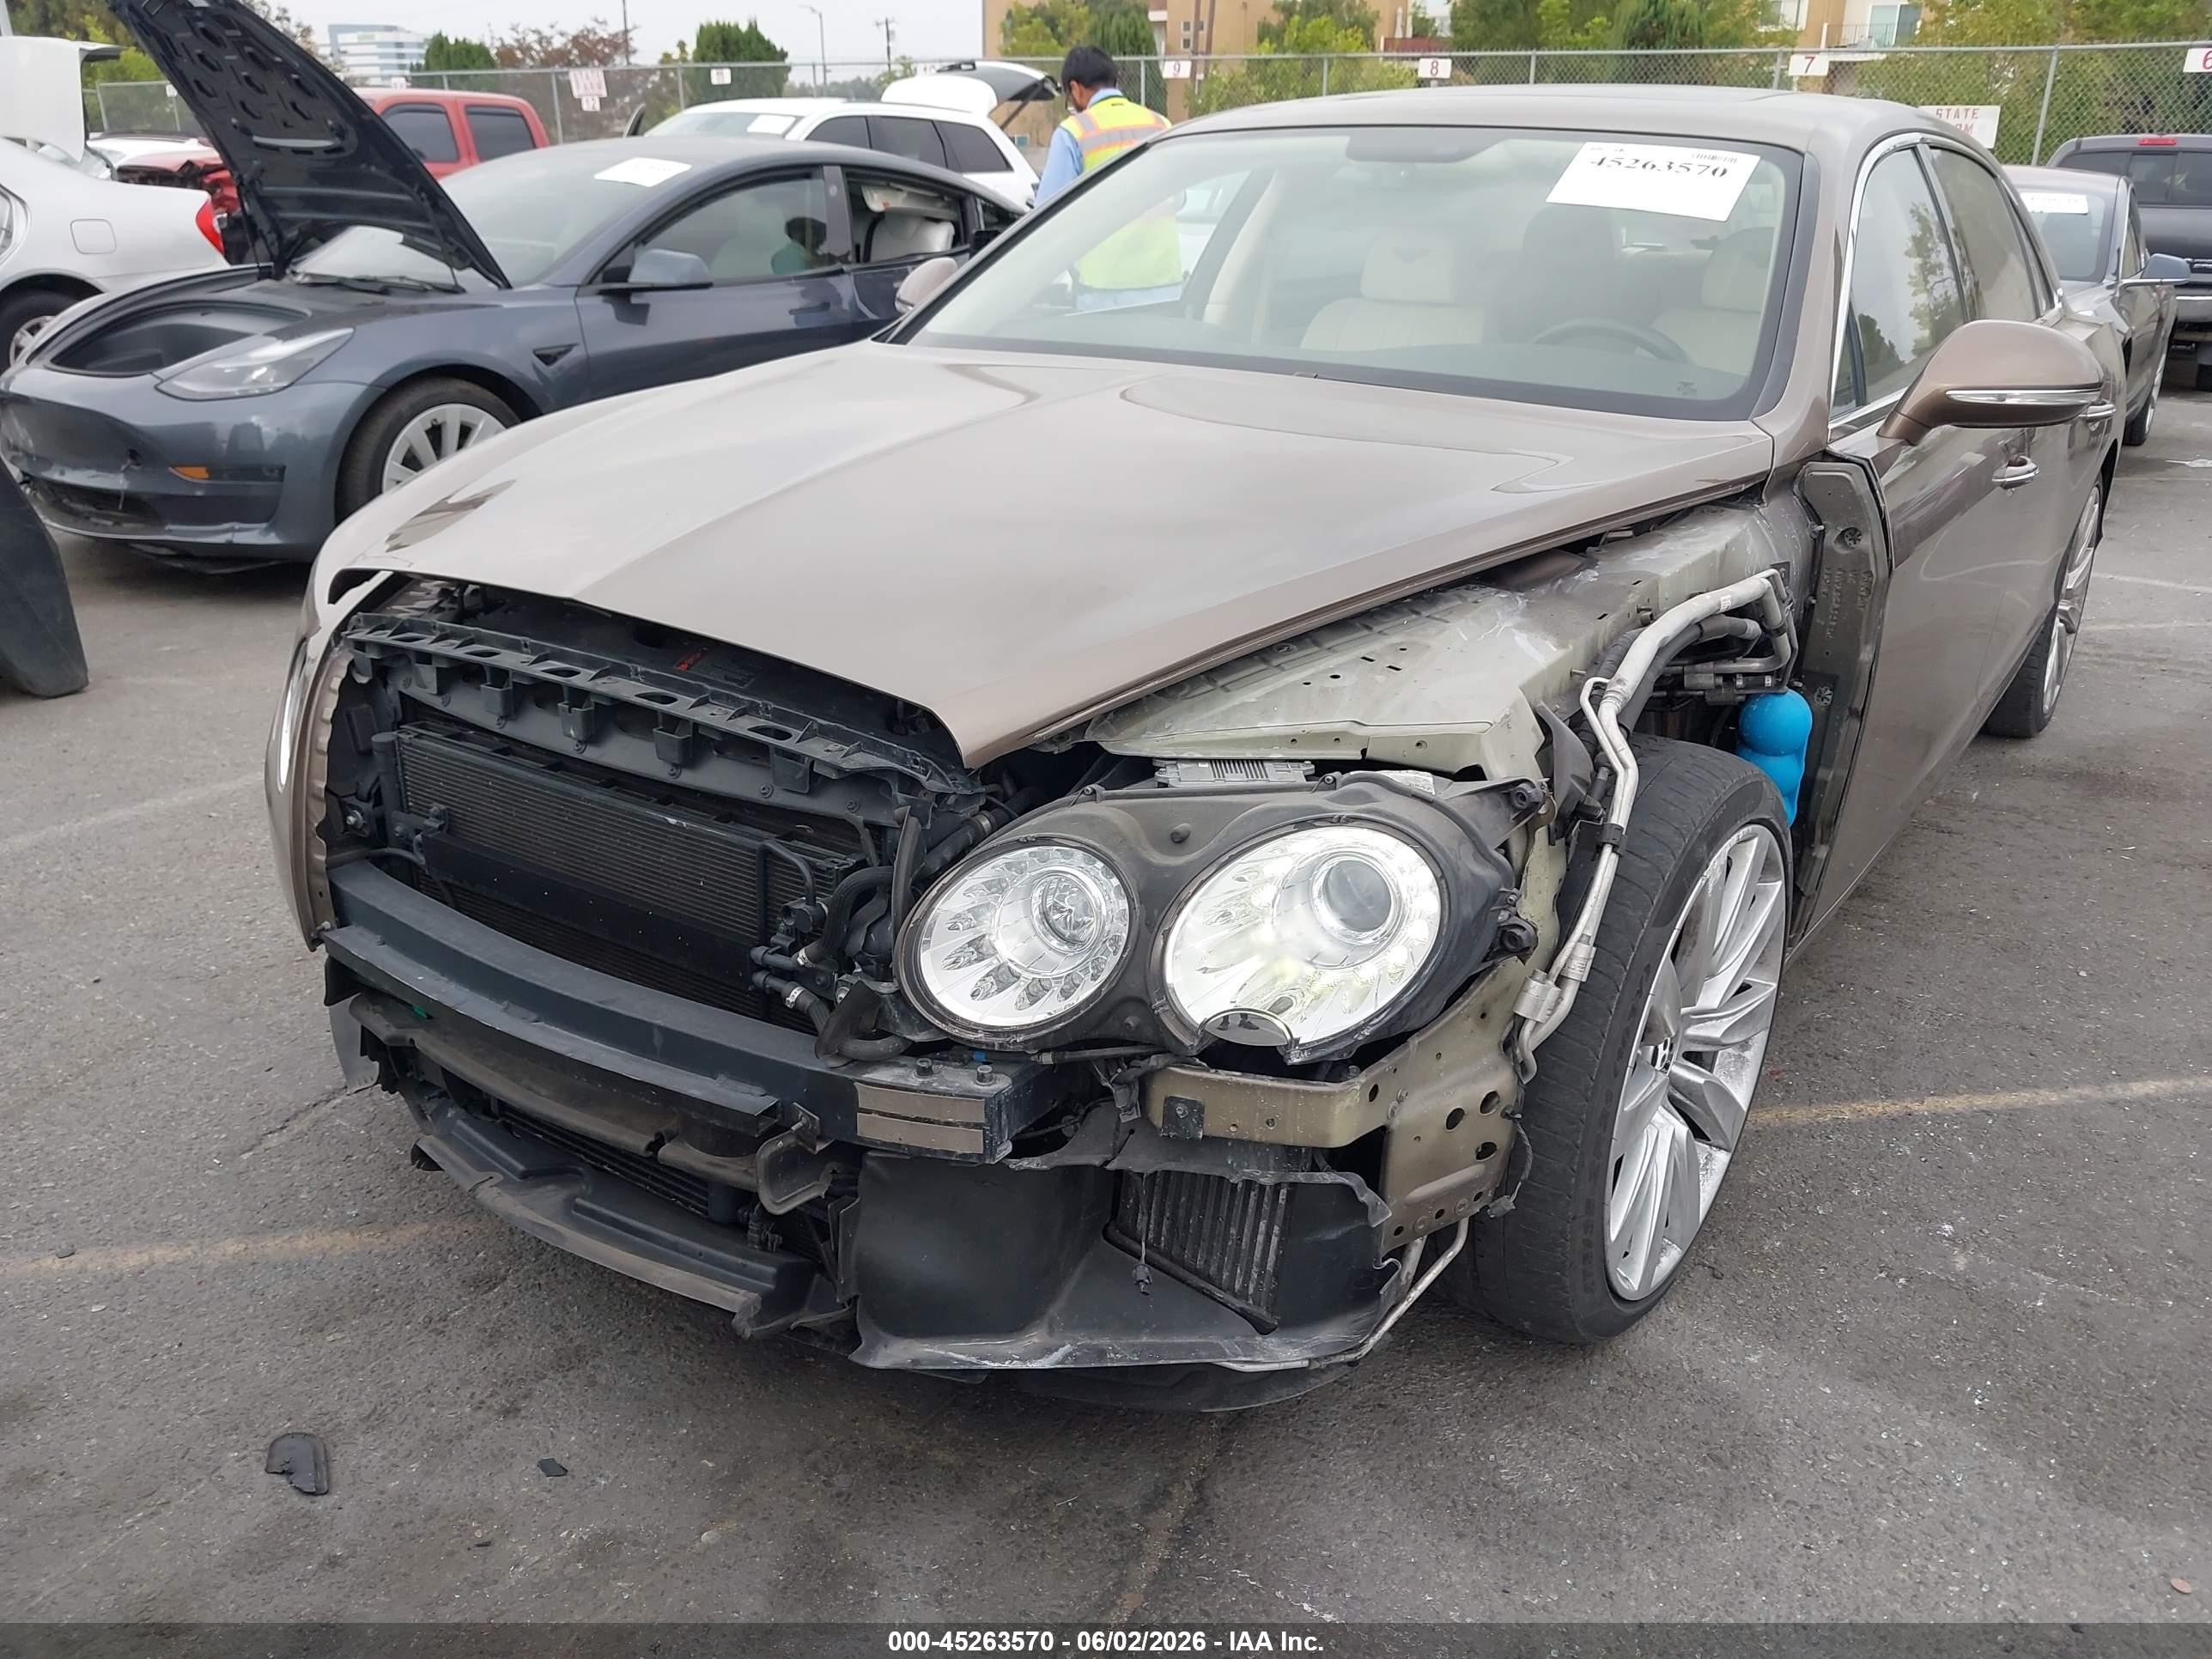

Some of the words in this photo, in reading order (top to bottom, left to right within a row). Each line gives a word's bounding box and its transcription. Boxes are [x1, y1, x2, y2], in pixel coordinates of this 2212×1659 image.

[1173, 61, 1181, 76] 9
[1430, 60, 1439, 76] 8
[1805, 56, 1815, 74] 7
[1936, 107, 1979, 119] STATE
[1590, 156, 1729, 178] 45263570
